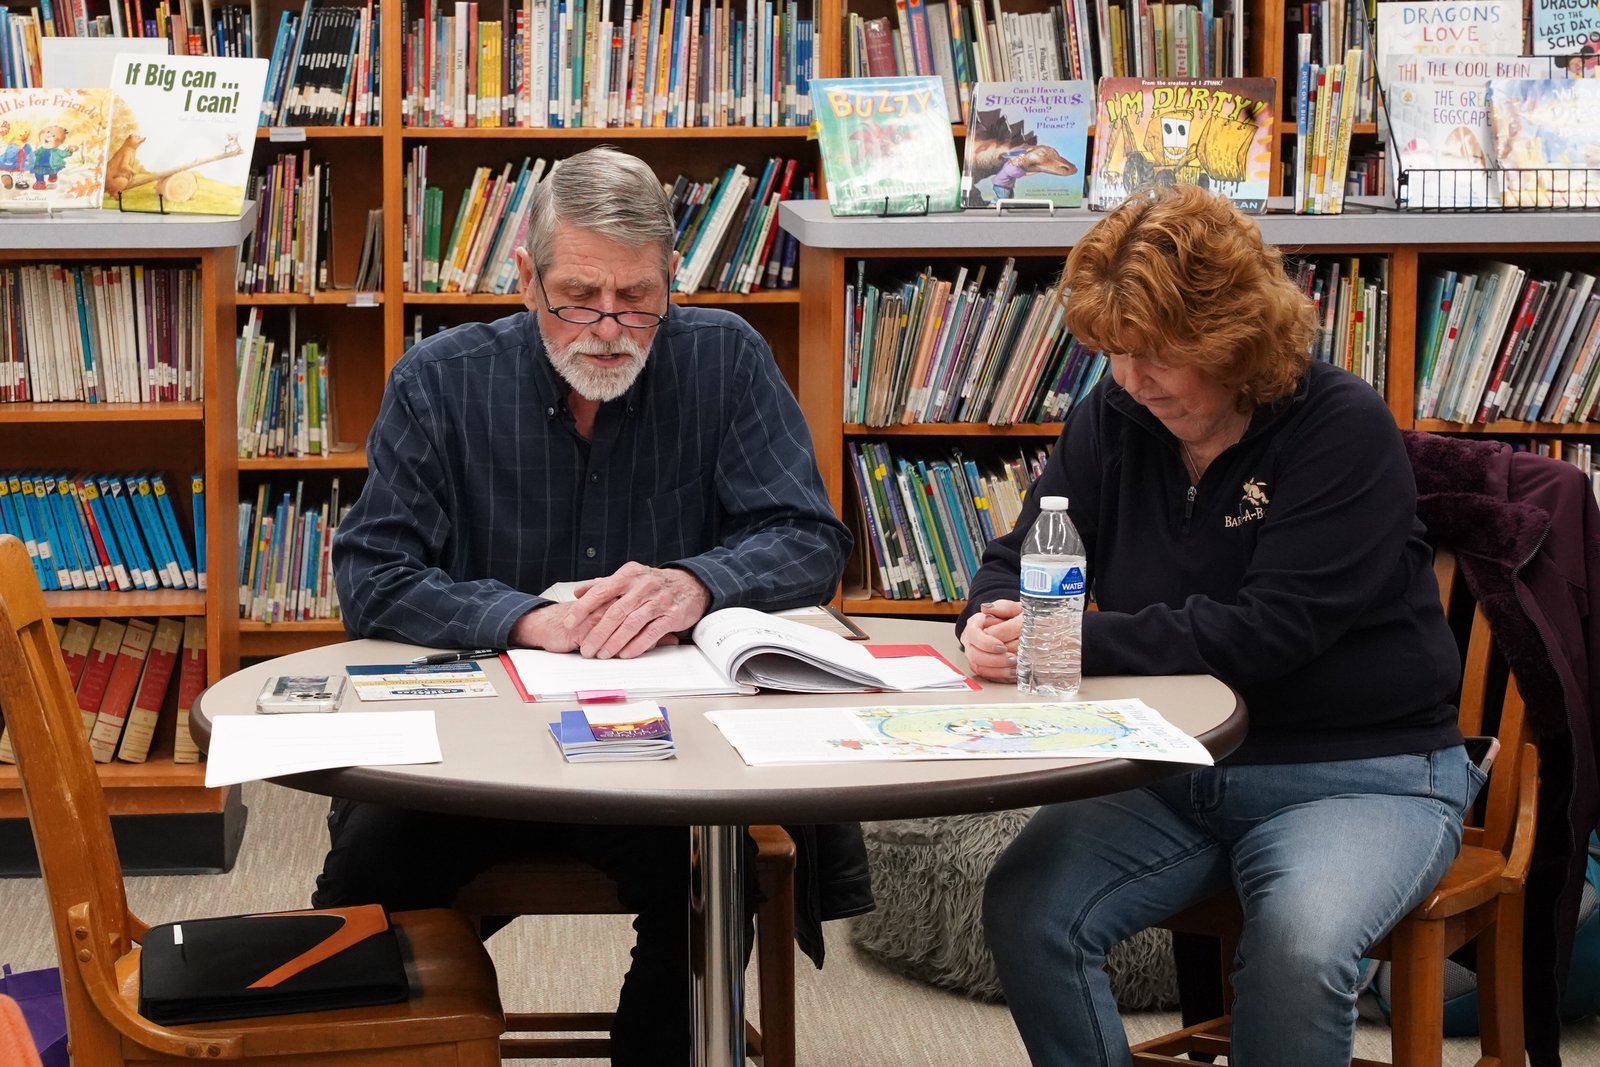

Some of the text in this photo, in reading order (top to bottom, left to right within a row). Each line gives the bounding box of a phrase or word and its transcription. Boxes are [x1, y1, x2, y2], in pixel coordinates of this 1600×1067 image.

[1404, 6, 1500, 24] DRAGONS
[1424, 26, 1478, 42] LOVE
[1539, 22, 1567, 37] LAST
[1571, 18, 1592, 31] DAY
[1547, 31, 1600, 50] SCHOO
[125, 63, 141, 85] If
[144, 64, 176, 92] Big
[182, 70, 216, 88] can
[1427, 62, 1530, 78] THE COOL BEAN
[14, 98, 24, 110] Is
[29, 93, 49, 108] for
[52, 94, 100, 118] Friends
[184, 90, 240, 114] I can!
[827, 89, 932, 118] BUZZY
[1105, 86, 1265, 124] I'M DIRTY!
[1302, 92, 1306, 100] ON
[1434, 90, 1490, 108] THE GREA
[1434, 108, 1492, 127] EGGSCAPE
[1062, 582, 1084, 591] WATER
